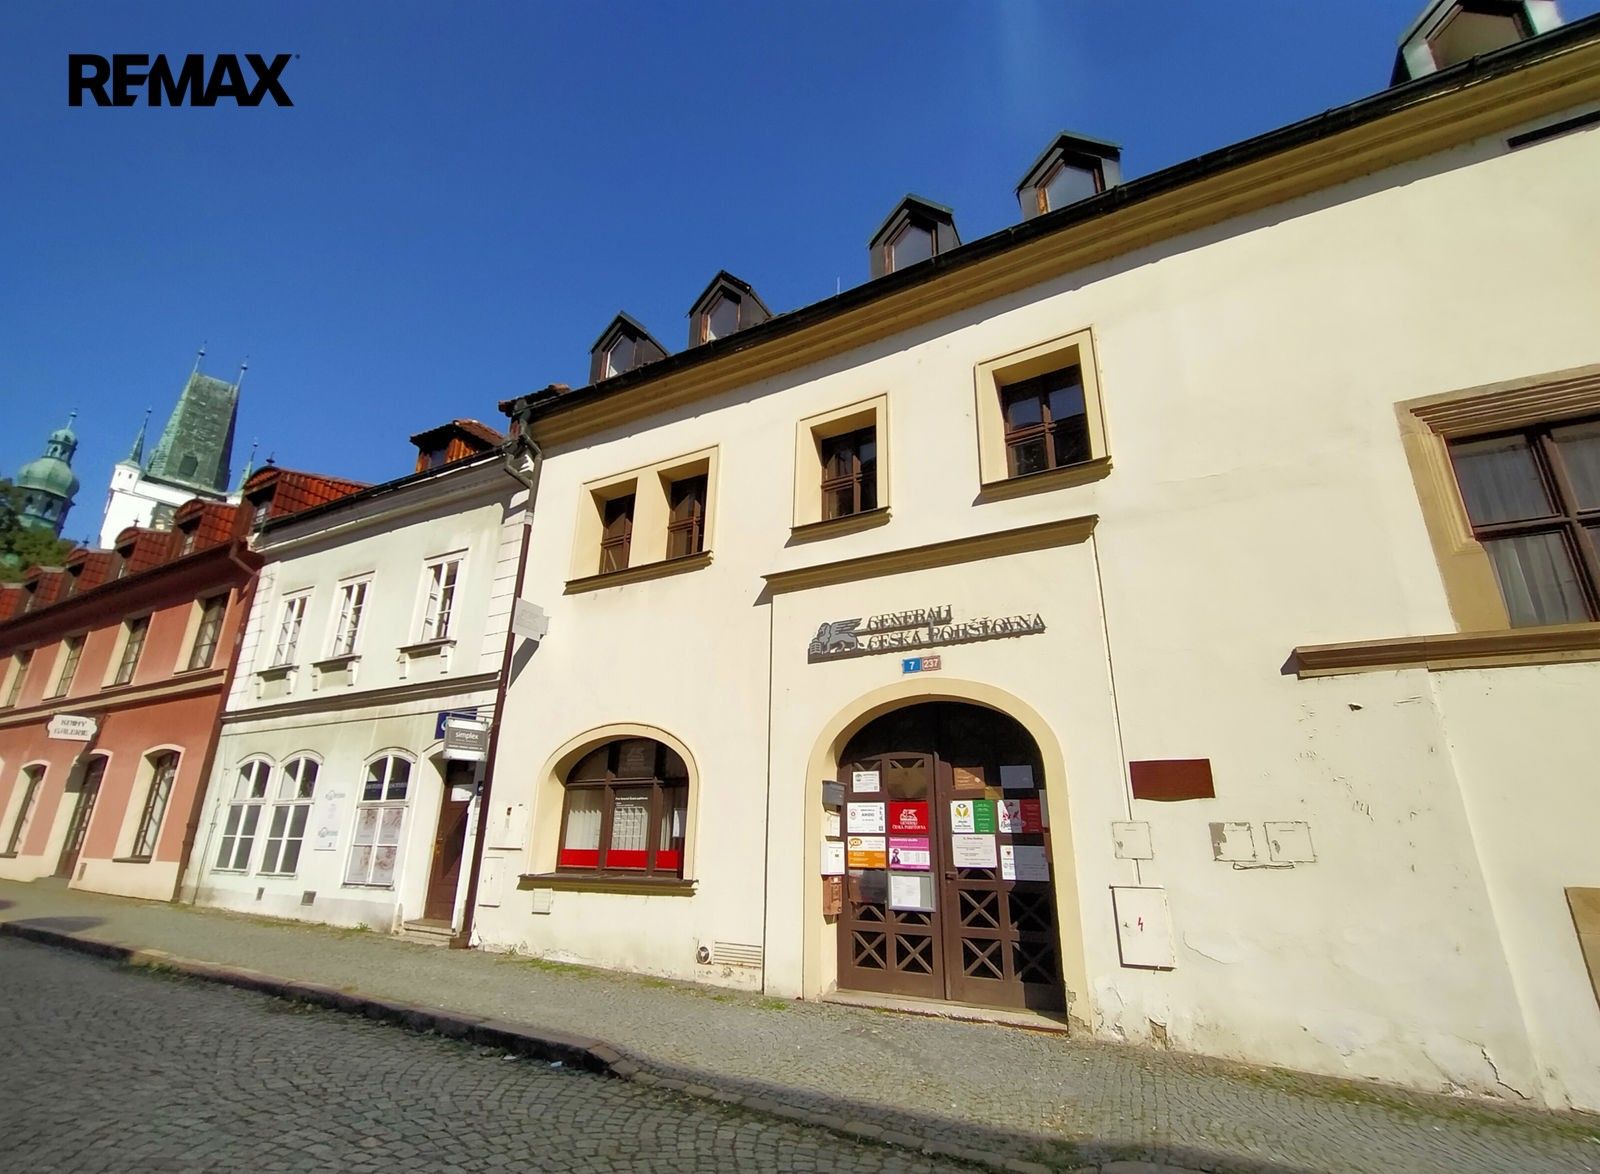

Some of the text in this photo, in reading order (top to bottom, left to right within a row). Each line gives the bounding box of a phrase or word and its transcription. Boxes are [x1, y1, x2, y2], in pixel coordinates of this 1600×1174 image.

[867, 604, 953, 631] GENERALI
[908, 658, 939, 671] 7 237
[455, 731, 479, 741] simplex
